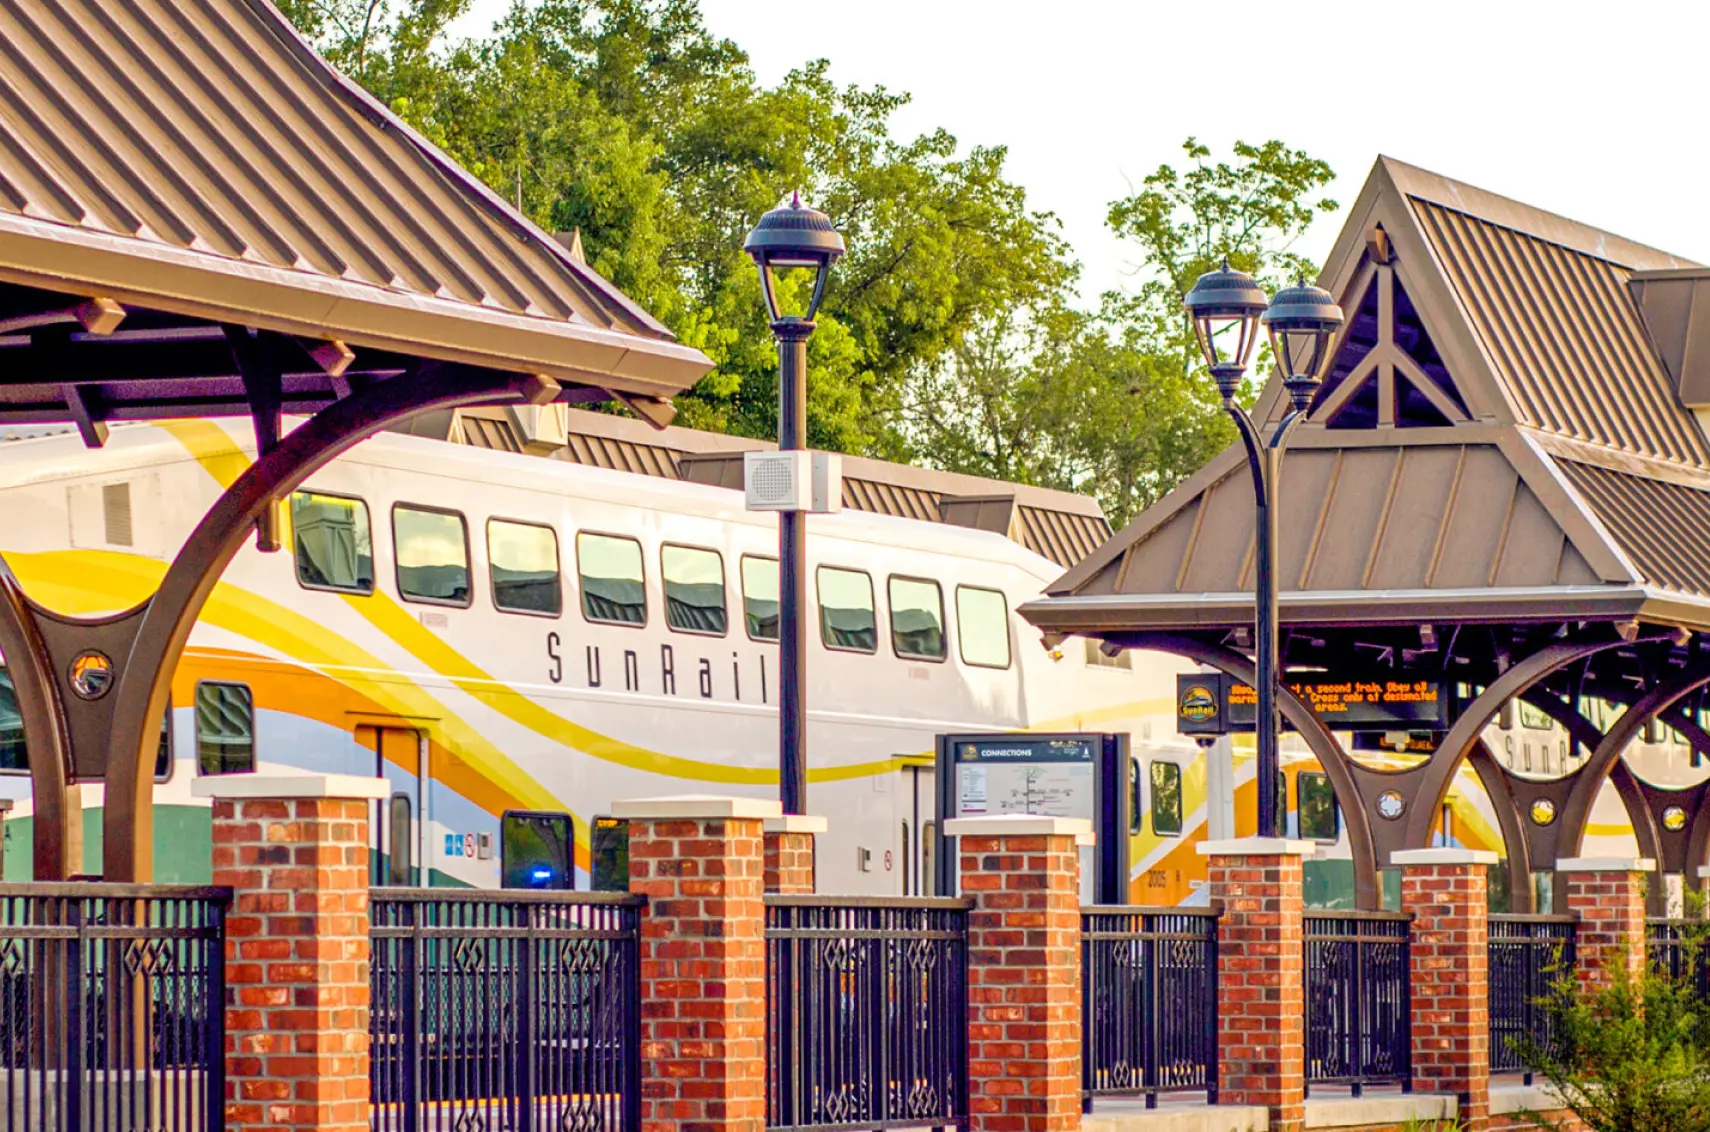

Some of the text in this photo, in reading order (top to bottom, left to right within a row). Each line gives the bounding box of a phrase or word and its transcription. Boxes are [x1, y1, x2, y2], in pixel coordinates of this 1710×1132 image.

[547, 631, 767, 704] SunRail
[1317, 682, 1352, 693] second
[1385, 681, 1411, 692] Obey
[1310, 692, 1339, 703] Cross
[1342, 692, 1364, 702] only
[1366, 691, 1379, 702] at
[1382, 690, 1438, 702] designated
[1314, 703, 1348, 712] areas.
[981, 748, 1033, 757] CONNECTIONS
[1504, 734, 1585, 775] SunR
